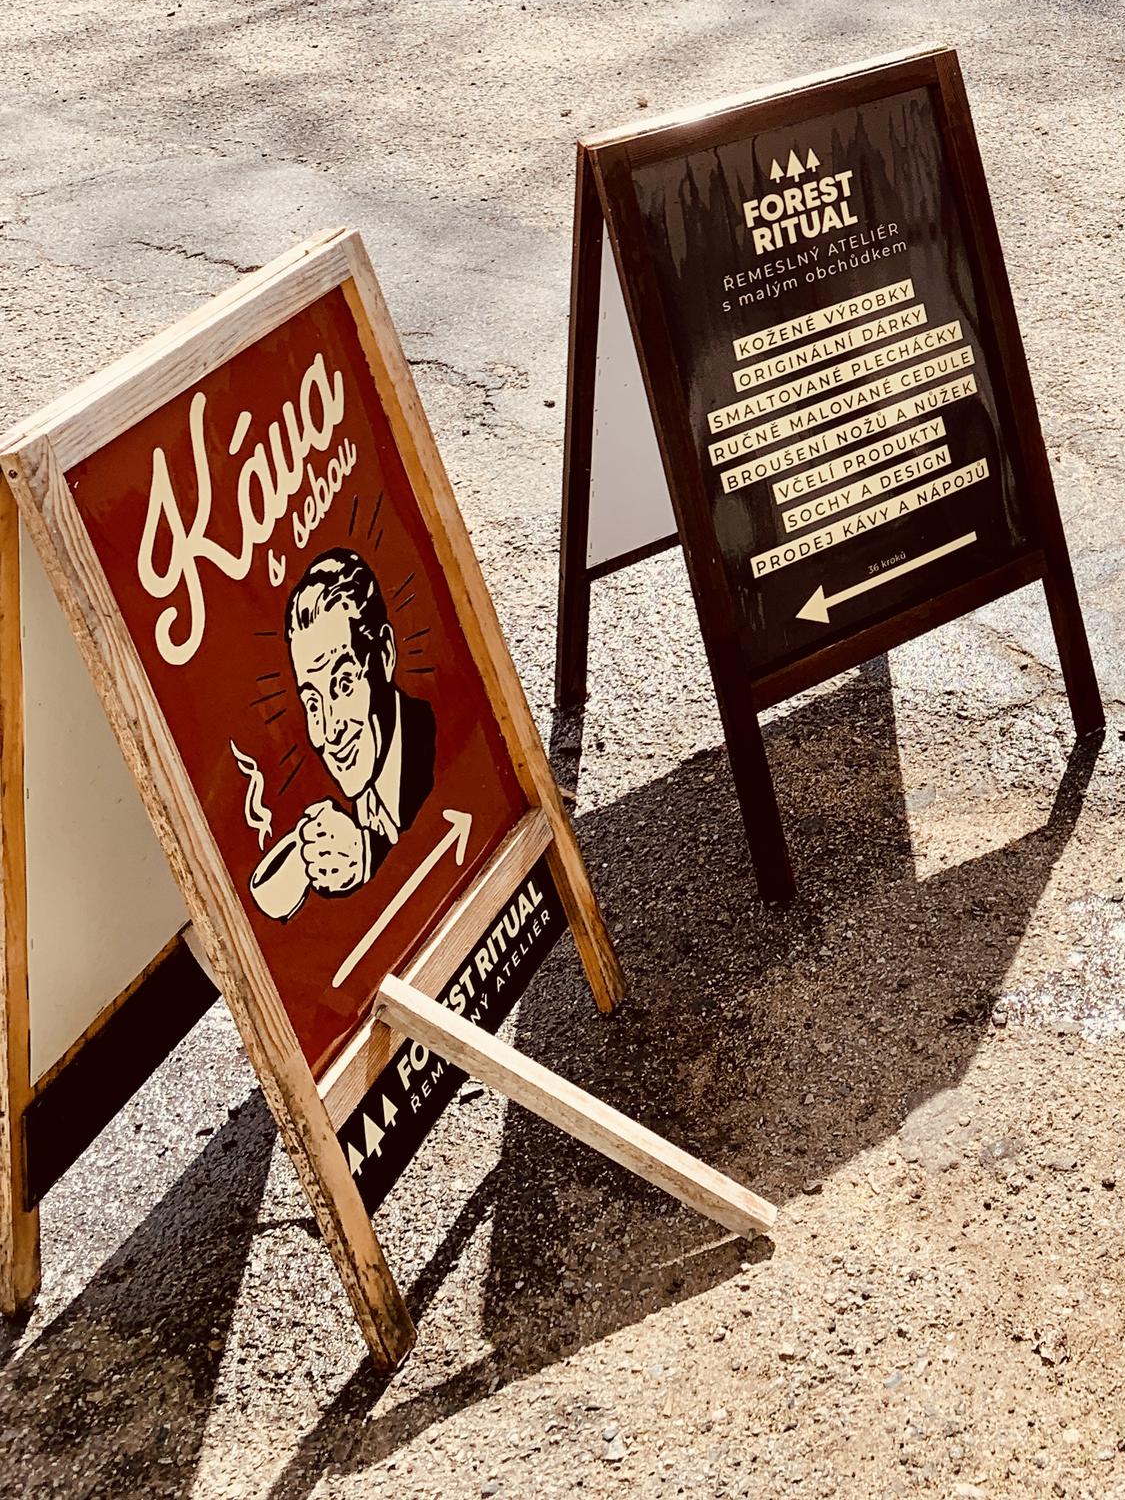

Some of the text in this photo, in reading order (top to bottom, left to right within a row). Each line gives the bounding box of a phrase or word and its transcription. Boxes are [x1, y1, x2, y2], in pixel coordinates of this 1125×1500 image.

[743, 170, 853, 228] FOREST
[752, 200, 858, 255] RITUAL
[722, 240, 907, 312] s malým obchůdkem
[723, 222, 899, 291] ŘEMESLNÝ ATELIÉR
[739, 284, 909, 356] KOŽENÉ VÝROBKY
[739, 309, 922, 387] ORIGINÁLNÍ DÁRKY
[713, 326, 957, 429] SMALTOVANÉ PLECHÁČKY
[714, 351, 971, 462] RUČNĚ MALOVANÉ CEDULE
[727, 380, 974, 490] BROUŠENÍ NOŽŮ A NŮŽEK
[778, 422, 940, 499] VČELÍ PRODUKTY
[137, 352, 345, 666] Káva
[268, 437, 357, 587] s sebou
[755, 461, 986, 574] PRODEJ KÁVY A NÁPOJŮ
[787, 451, 947, 528] SOCHY A DESIGN
[868, 563, 880, 575] 36
[397, 880, 544, 1091] FOST RITUAL
[410, 909, 551, 1113] ŘEMNÝ ATELIÉR
